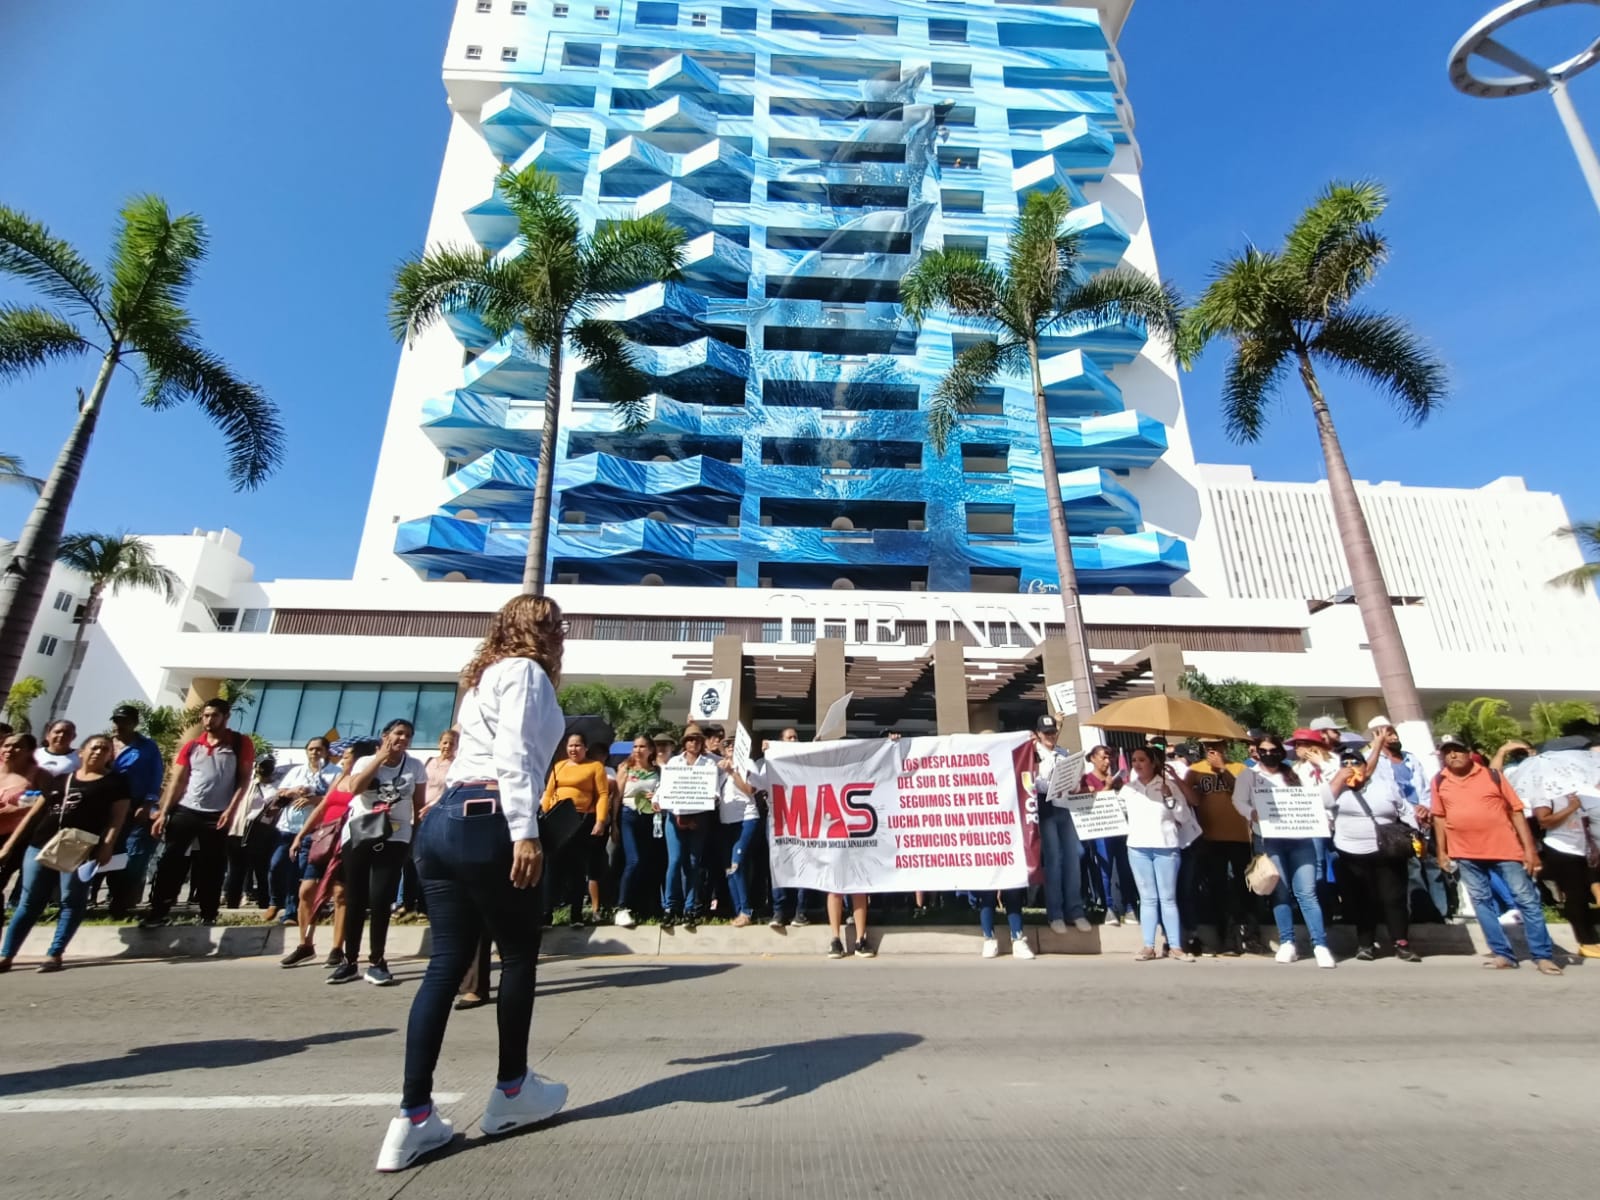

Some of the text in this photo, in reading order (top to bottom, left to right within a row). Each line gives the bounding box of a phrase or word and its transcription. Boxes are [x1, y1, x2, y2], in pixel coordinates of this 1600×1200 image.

[901, 753, 990, 772] LOS DESPLAZADOS
[897, 772, 998, 789] DEL SUR DE SINALOA,
[899, 791, 1000, 809] SEGUIMOS EN PIE DE
[771, 782, 878, 839] MAS
[887, 810, 1016, 829] LUCHA POR UNA VIVIENDA
[895, 831, 1012, 848] Y SERVICIOS PÚBLICOS
[895, 851, 1015, 869] ASISTENCIALES DIGNOS
